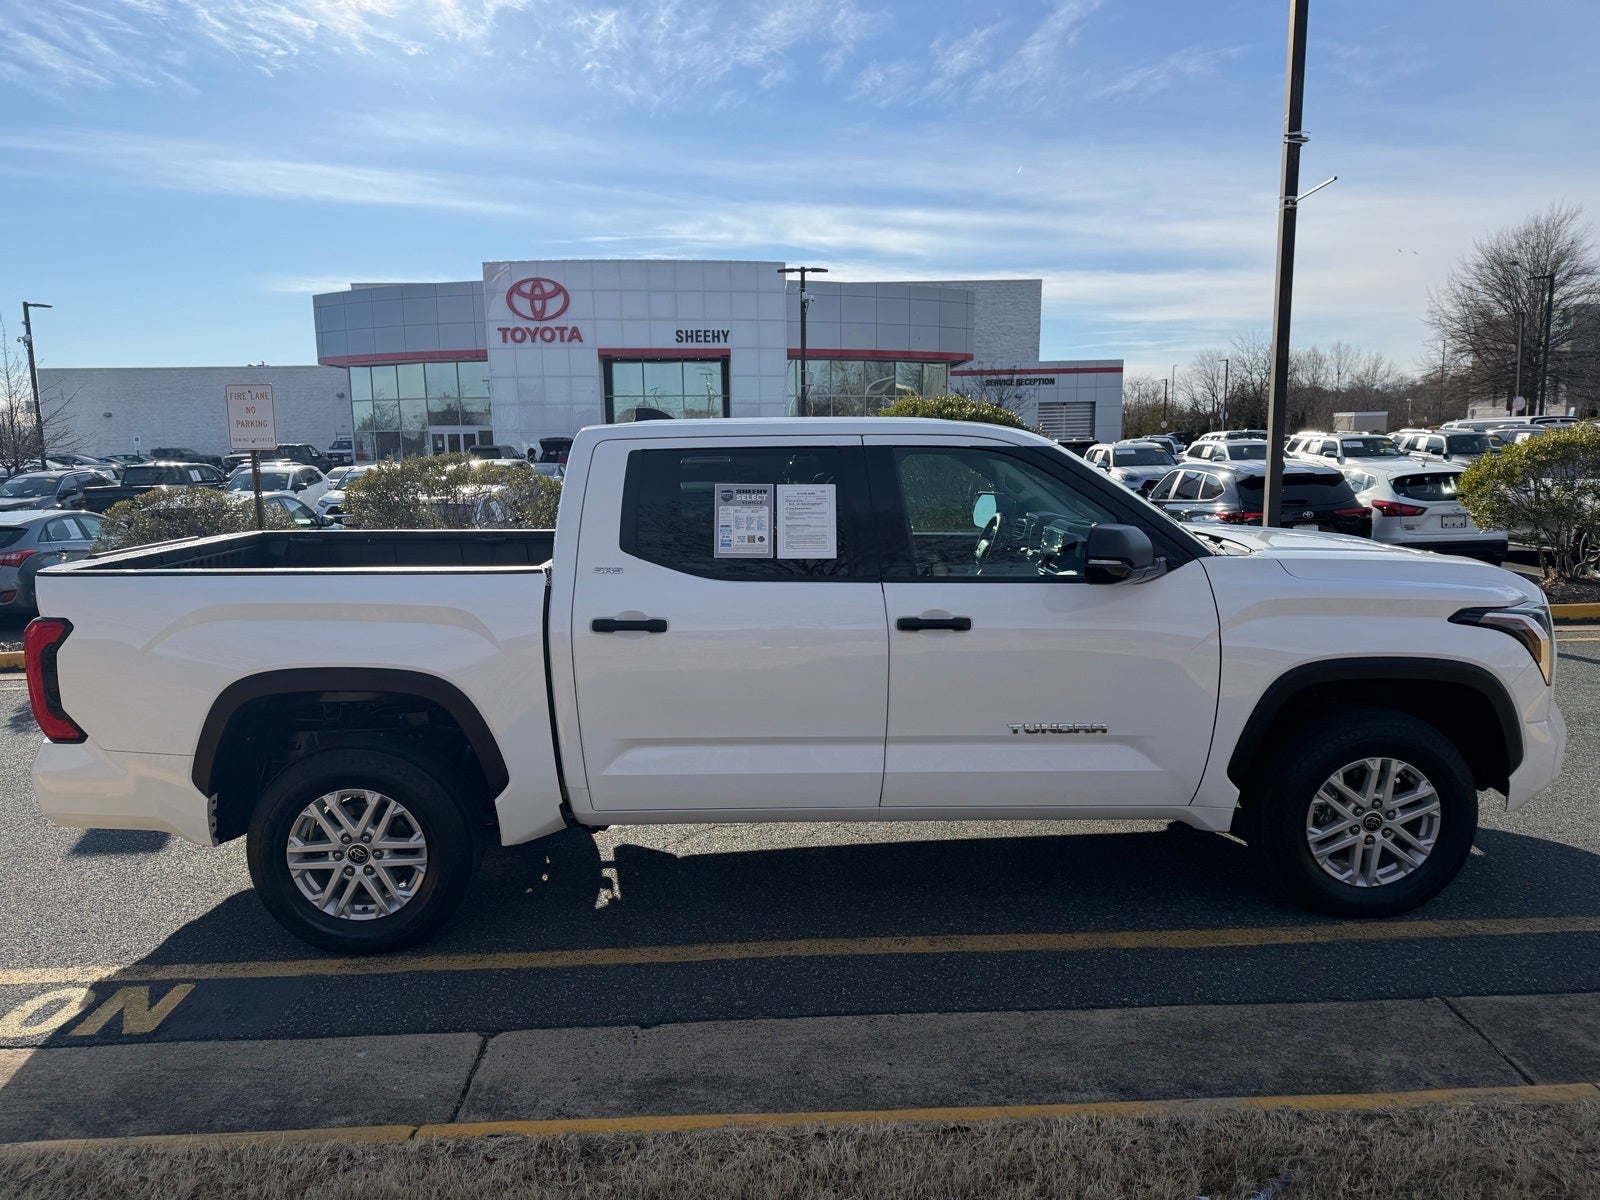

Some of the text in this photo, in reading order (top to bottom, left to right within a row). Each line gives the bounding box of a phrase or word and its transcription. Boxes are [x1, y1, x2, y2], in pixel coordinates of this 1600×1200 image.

[497, 326, 583, 343] TOYOTA
[675, 329, 730, 343] SHEEHY
[1016, 378, 1055, 386] RECEPTION
[229, 392, 269, 400] FIRE LANE
[245, 406, 256, 414] NO
[236, 420, 268, 428] PARKING
[1007, 723, 1108, 734] TUNDRA
